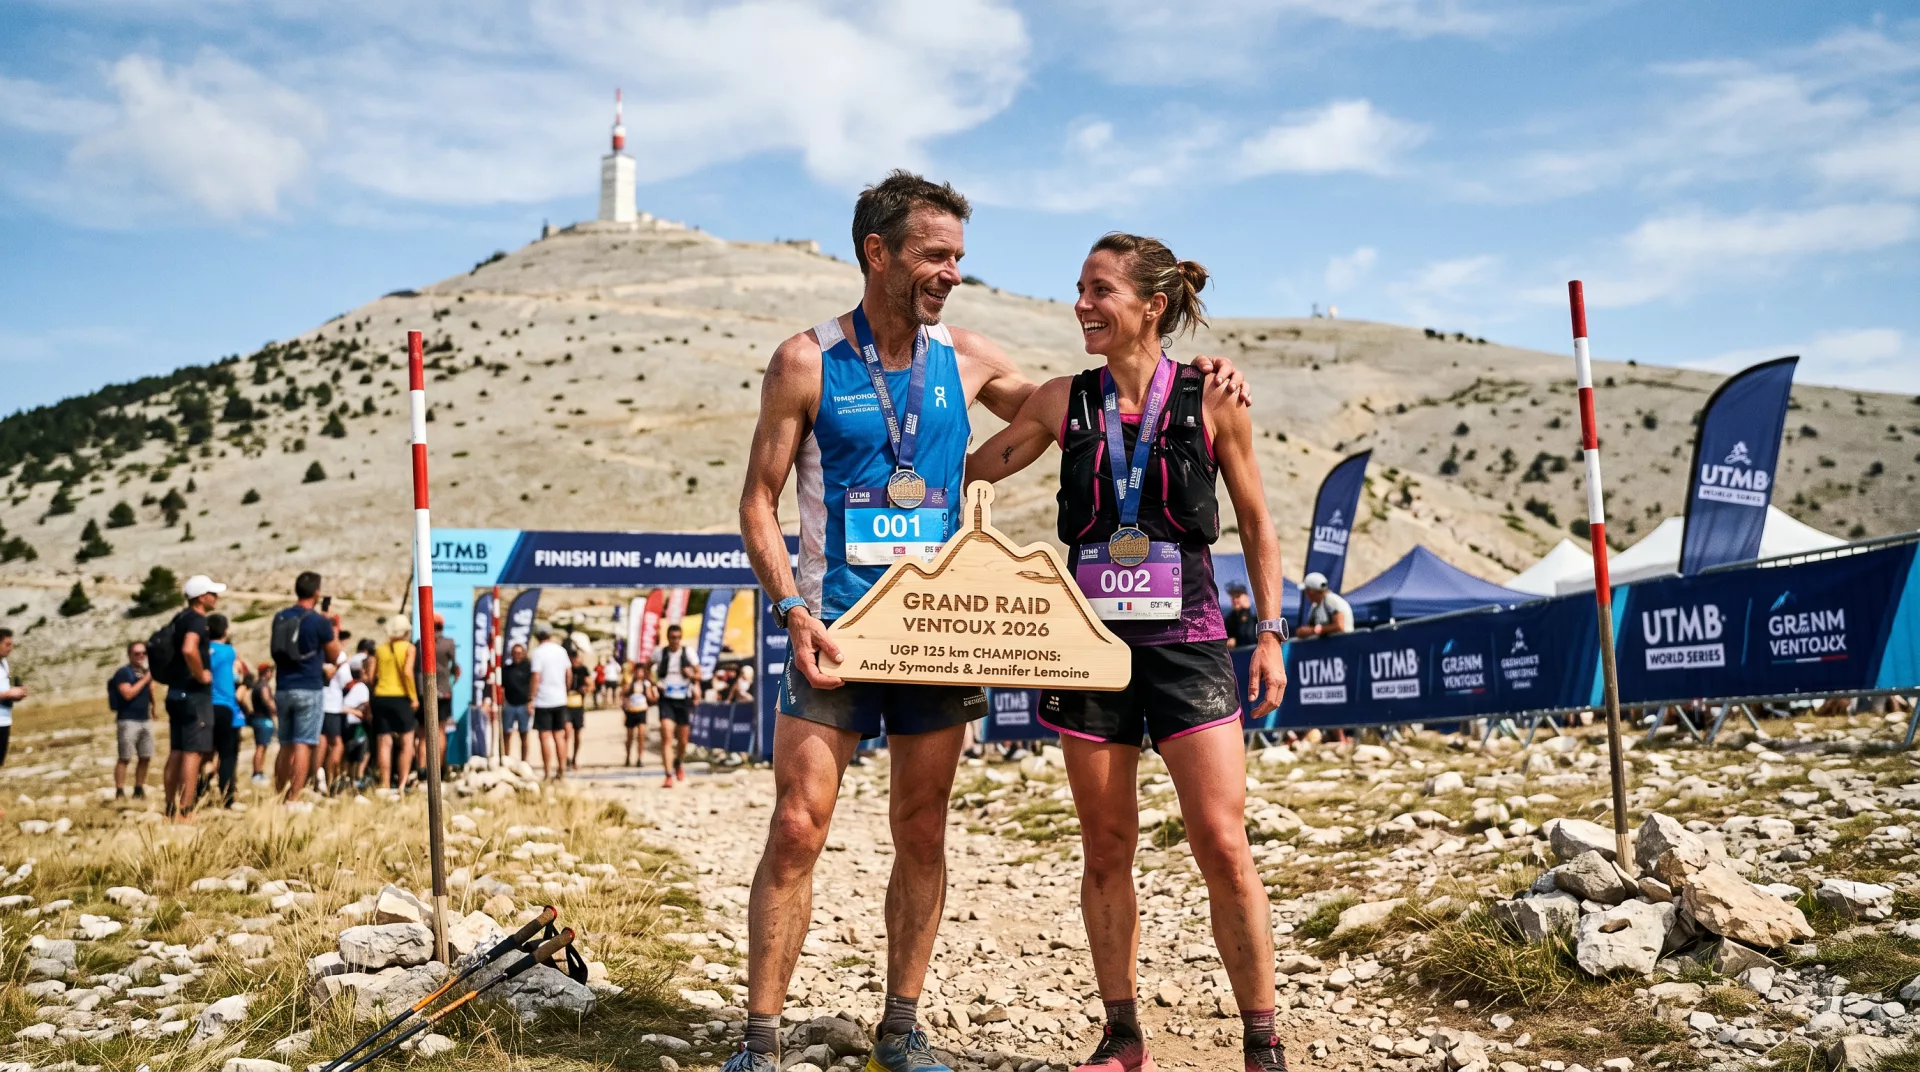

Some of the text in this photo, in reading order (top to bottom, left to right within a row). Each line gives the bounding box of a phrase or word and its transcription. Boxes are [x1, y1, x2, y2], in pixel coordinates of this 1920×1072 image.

[1701, 463, 1769, 491] UTMB
[873, 514, 921, 538] 001
[534, 550, 597, 567] FINISH
[600, 551, 641, 568] LINE
[1100, 569, 1151, 593] 002
[903, 592, 1051, 615] GRAND RAID
[903, 617, 1050, 637] VENTOUX 2026
[1642, 604, 1723, 645] UTMB
[890, 644, 1061, 662] UGP 125 km CHAMPIONS:
[1370, 648, 1418, 679] UTMB
[1649, 649, 1721, 665] WORLD SERIES
[859, 659, 1090, 679] Andy Symonds & Jennifer Lemoine
[1299, 657, 1346, 686] UTMB
